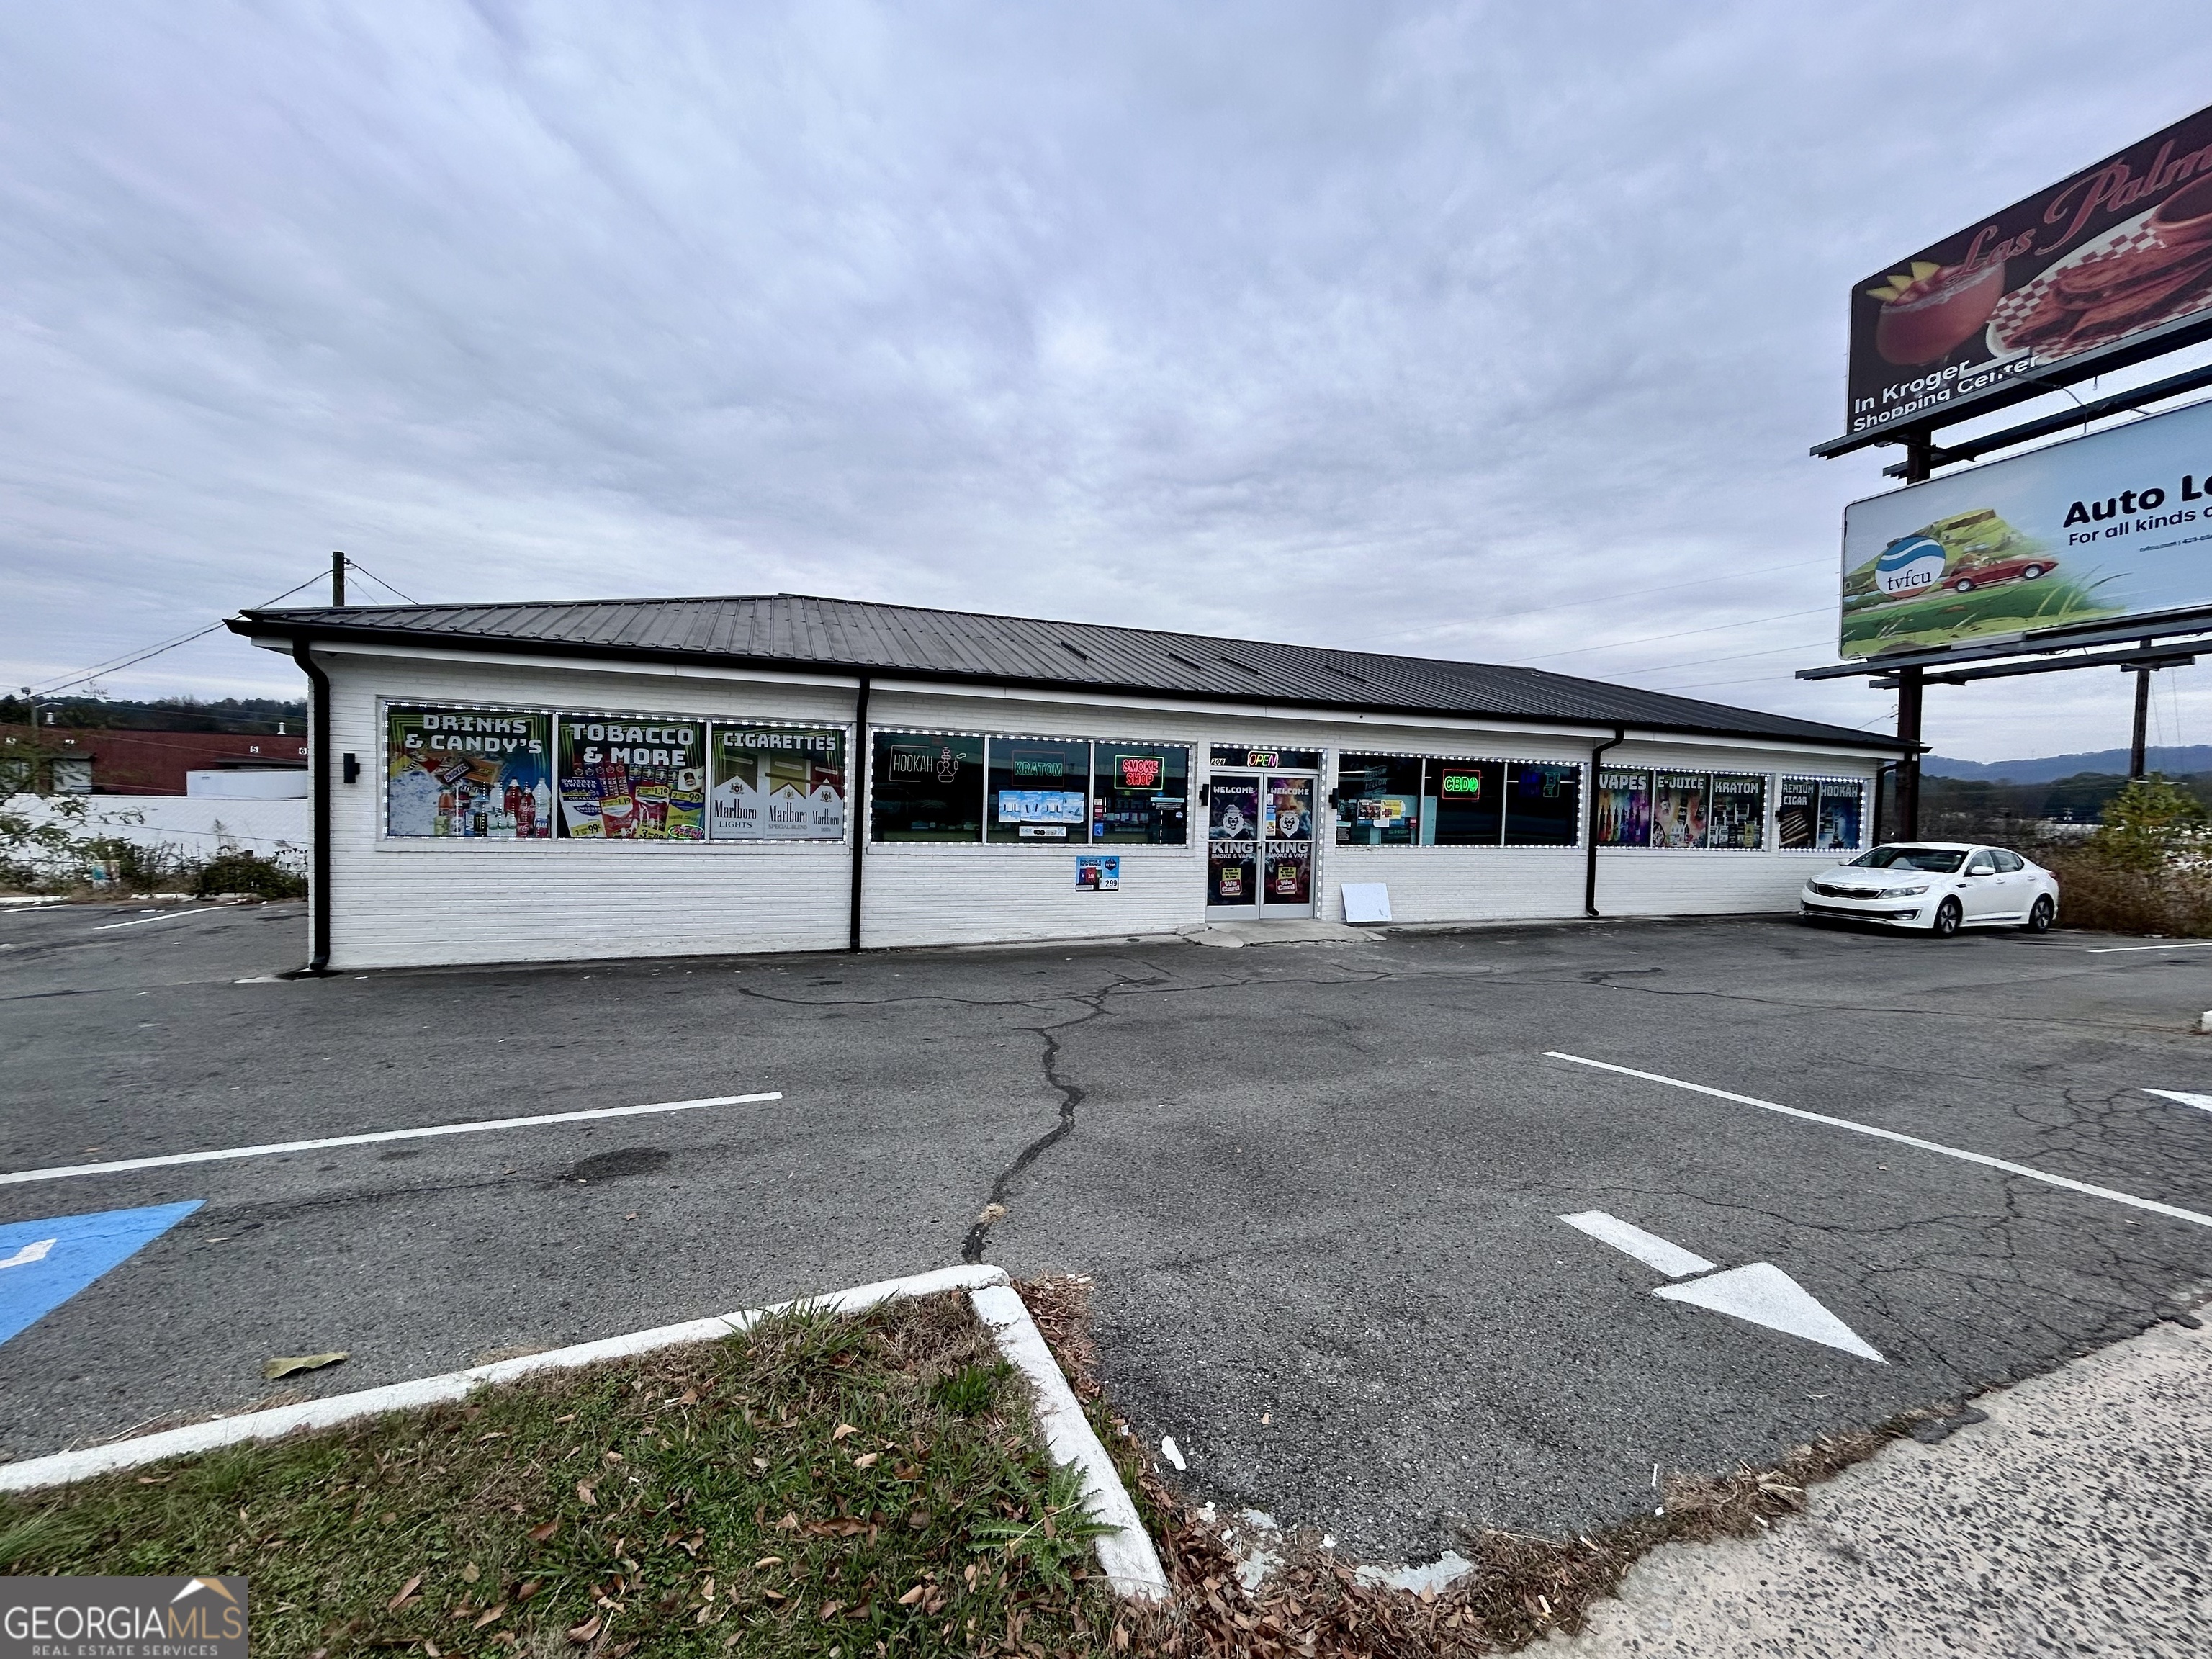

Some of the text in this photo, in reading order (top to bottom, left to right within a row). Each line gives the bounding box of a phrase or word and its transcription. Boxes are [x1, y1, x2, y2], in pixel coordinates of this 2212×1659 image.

[1944, 225, 2037, 287] Las
[1853, 354, 2040, 432] Shopping Center
[1854, 360, 1970, 414] In Kroger
[2063, 487, 2165, 529] Auto
[2069, 529, 2100, 547] For
[2105, 521, 2129, 539] all
[2136, 510, 2196, 532] kinds
[1887, 570, 1933, 591] tvfcu
[423, 714, 526, 734] DRINKS
[405, 733, 542, 754] & CANDY'S
[569, 723, 694, 745] TOBACCO
[723, 732, 836, 751] CIGARETTES
[583, 746, 686, 766] & MORE
[893, 754, 933, 773] HOOKAH
[1249, 754, 1277, 767] OPEN
[1014, 761, 1063, 777] KRATOM
[1122, 759, 1159, 773] SMOKE
[1125, 773, 1154, 786] SHOP
[1444, 776, 1470, 792] CBD
[1599, 773, 1647, 791] VAPES
[1658, 777, 1704, 790] E-JUICE
[1714, 781, 1759, 794] KRATOM
[1783, 796, 1807, 806] CIGAR
[1821, 786, 1858, 798] HOOKAH
[714, 798, 757, 820] Marlboro
[768, 802, 807, 823] Marlboro
[812, 808, 840, 826] Marlboro
[1211, 842, 1254, 853] KING
[1269, 842, 1308, 853] KING
